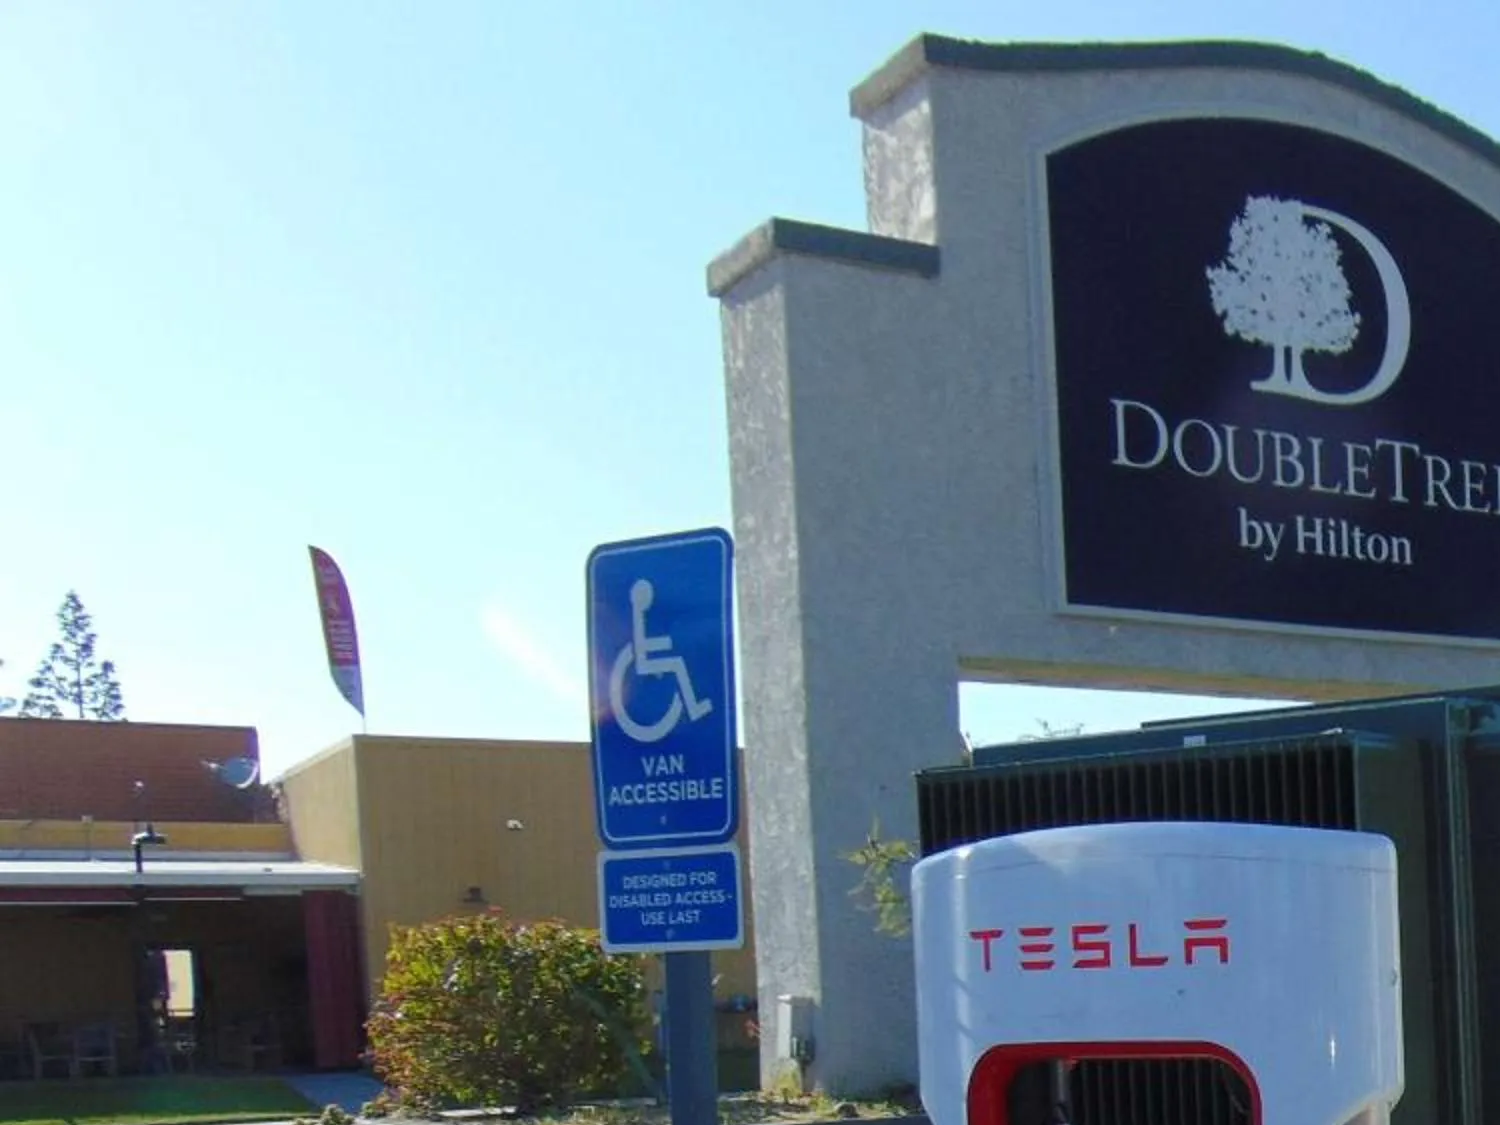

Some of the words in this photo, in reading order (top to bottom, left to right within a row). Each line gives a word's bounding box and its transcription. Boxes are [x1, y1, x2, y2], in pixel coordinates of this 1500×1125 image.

[1237, 507, 1285, 561] by
[1296, 514, 1413, 566] Hilton
[640, 753, 685, 778] VAN
[608, 777, 725, 807] ACCESSIBLE
[622, 873, 687, 889] DESIGNED
[689, 870, 717, 886] FOR
[608, 892, 672, 909] DISABLED
[641, 910, 666, 925] USE
[668, 909, 702, 925] LAST
[968, 918, 1230, 974] TESLA
